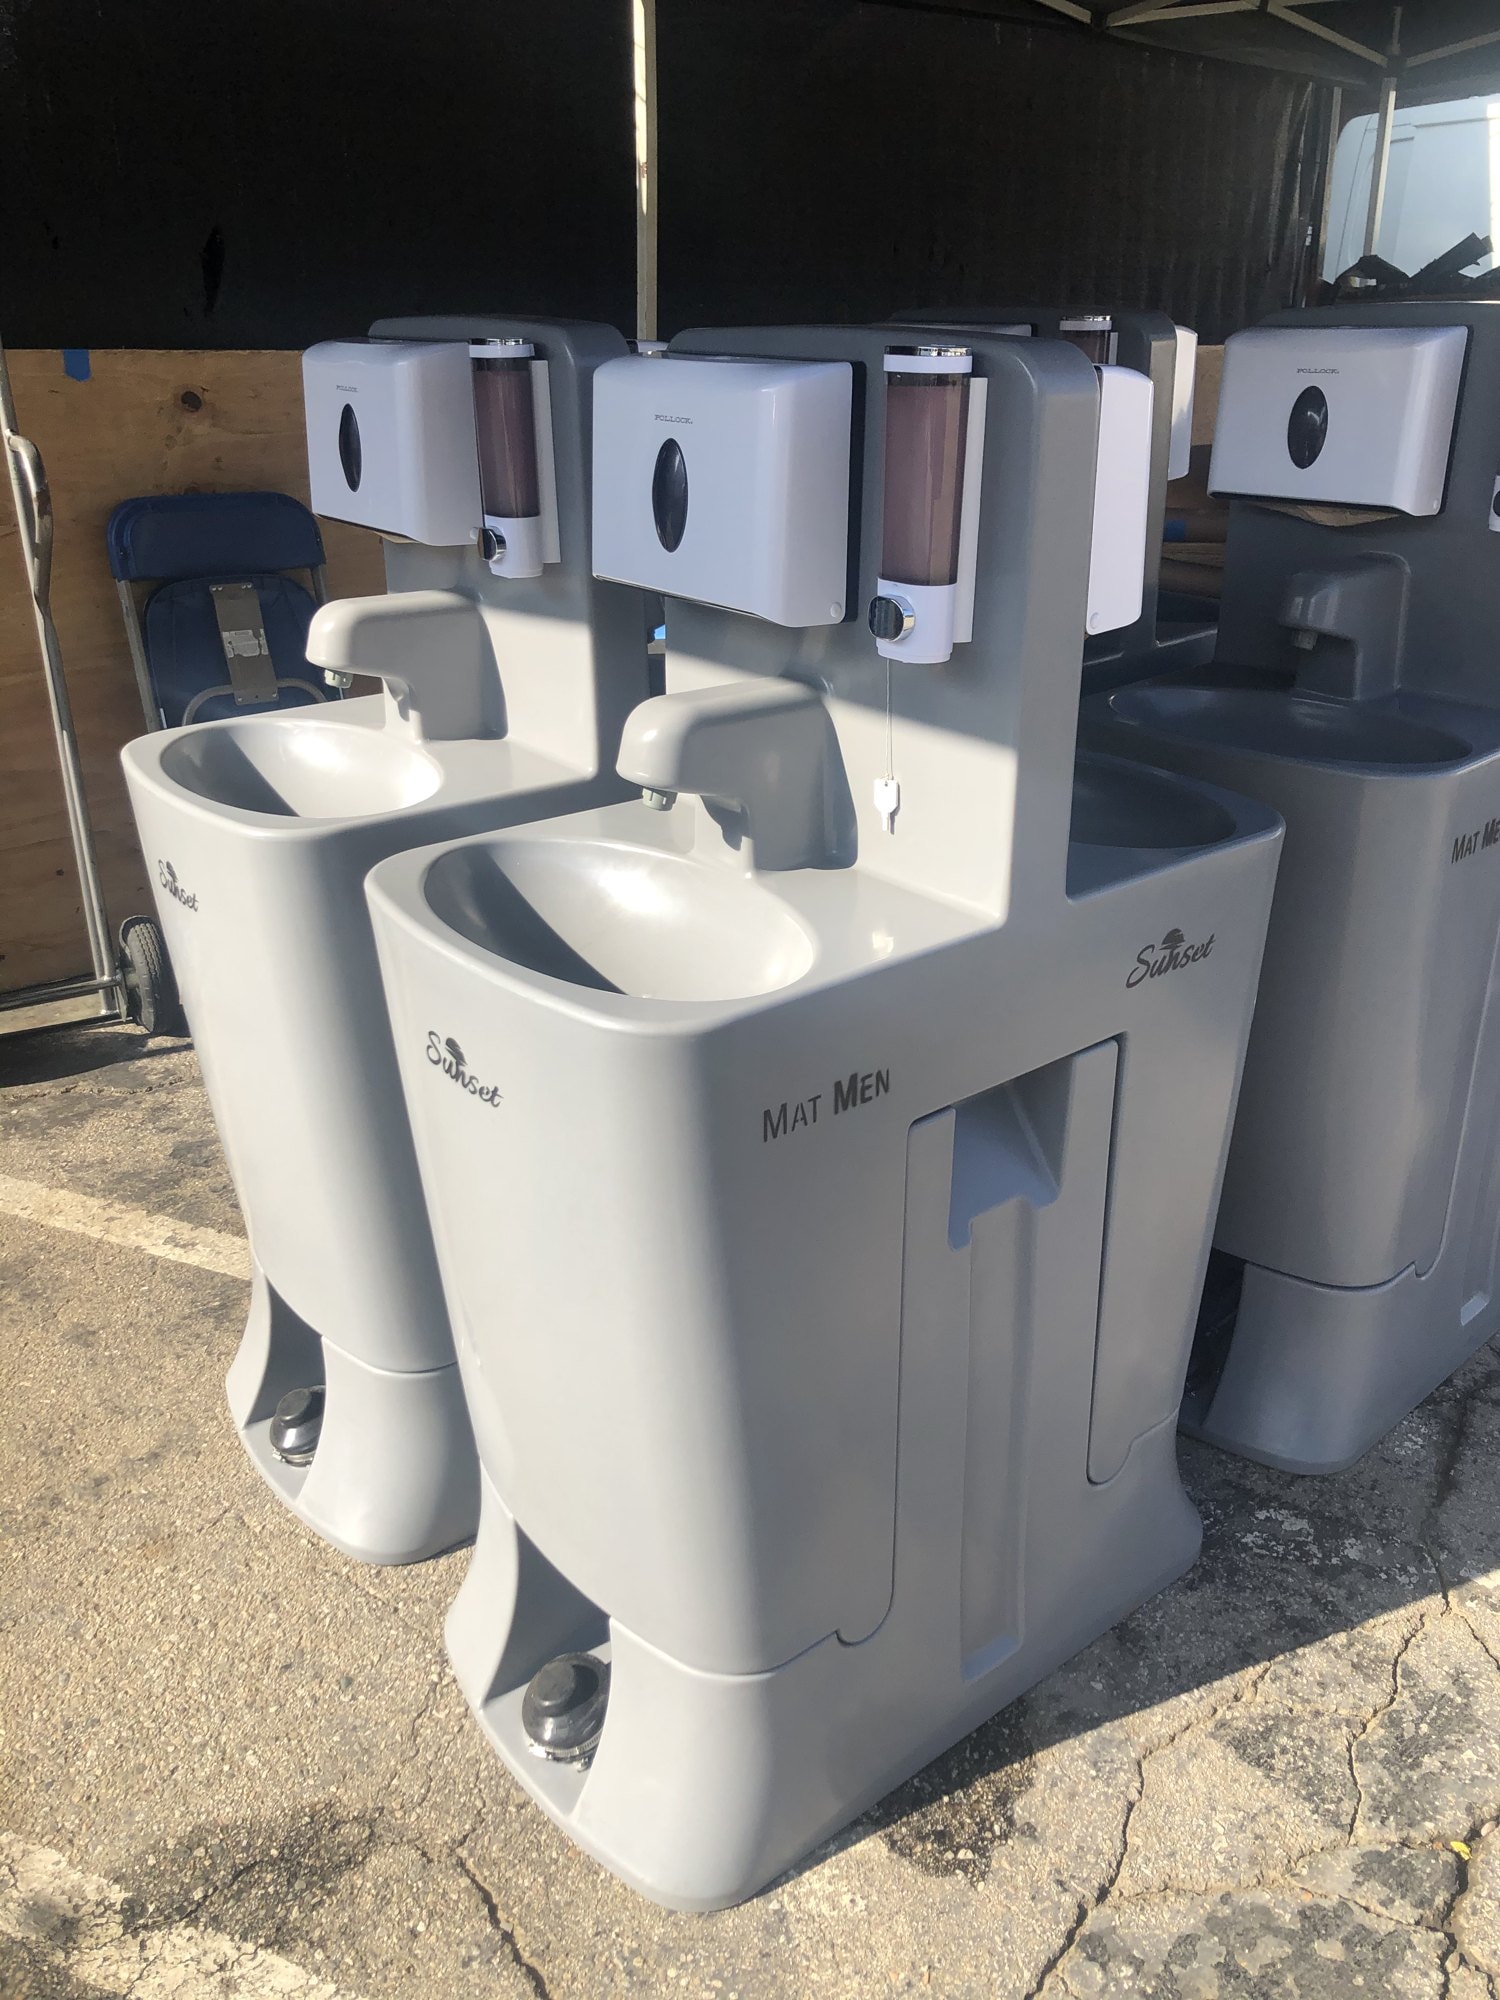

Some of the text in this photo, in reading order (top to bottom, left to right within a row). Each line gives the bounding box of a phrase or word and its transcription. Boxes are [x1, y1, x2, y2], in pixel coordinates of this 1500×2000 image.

[1452, 831, 1480, 864] MAT
[158, 859, 200, 912] Sunset
[1126, 930, 1215, 989] Sunset
[426, 1030, 504, 1108] Sunset
[763, 1067, 890, 1143] MAT MEN
